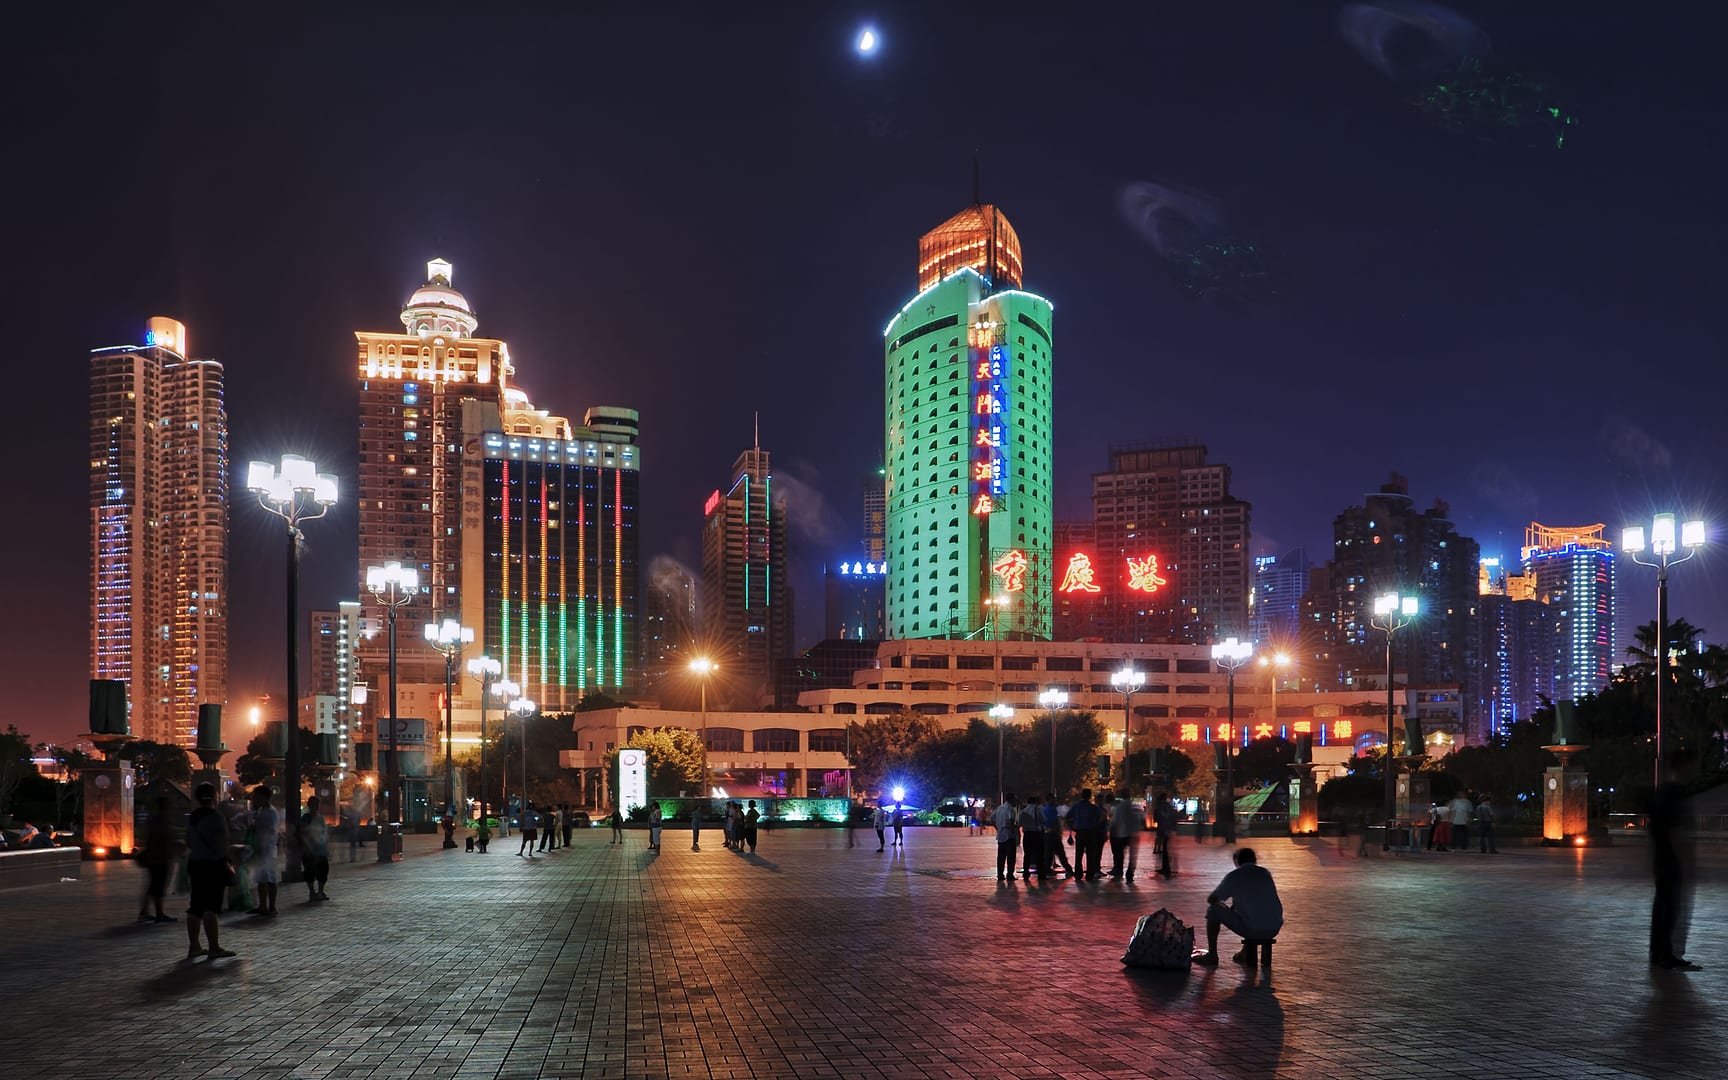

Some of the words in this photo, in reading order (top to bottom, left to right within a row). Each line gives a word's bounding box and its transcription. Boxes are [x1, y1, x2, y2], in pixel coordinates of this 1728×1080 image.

[993, 345, 1001, 376] CHAO
[993, 426, 1001, 447] MEN
[993, 458, 1001, 494] HOTEL
